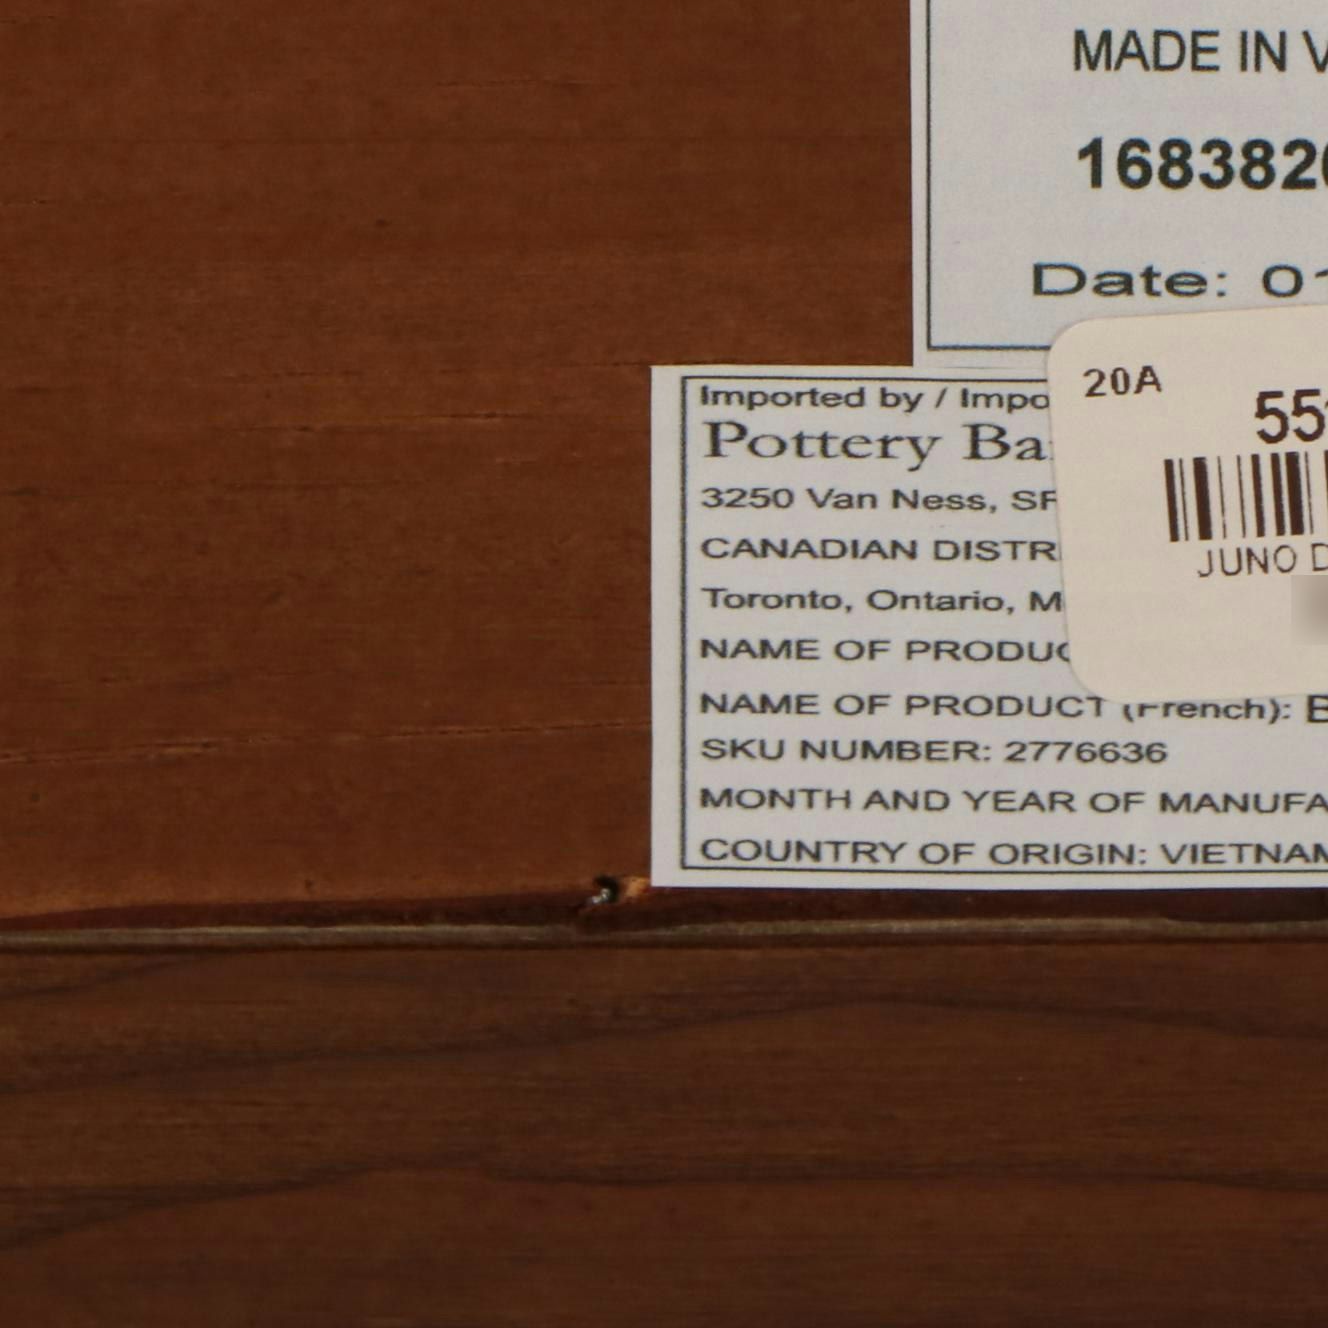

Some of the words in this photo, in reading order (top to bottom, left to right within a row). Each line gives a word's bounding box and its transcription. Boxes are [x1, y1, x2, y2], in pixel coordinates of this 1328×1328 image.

[1073, 28, 1221, 73] MADE
[1239, 29, 1288, 73] IN
[1032, 262, 1227, 295] Date:
[1082, 364, 1163, 398] 20A
[700, 384, 866, 412] Imported
[879, 386, 925, 414] by
[702, 419, 943, 473] Pottery
[700, 487, 795, 510] 3250
[805, 487, 878, 511] Van
[891, 488, 998, 514] Ness,
[1010, 489, 1057, 512] SF
[700, 537, 918, 561] CANADIAN
[1197, 544, 1297, 578] JUNO
[700, 587, 853, 614] Toronto,
[865, 588, 1015, 616] Ontario,
[699, 638, 821, 661] NAME
[833, 639, 891, 662] OF
[699, 692, 820, 716] NAME
[833, 693, 892, 717] OF
[904, 694, 1105, 718] PRODUCT
[700, 738, 785, 762] SKU
[799, 739, 991, 763] NUMBER:
[1004, 740, 1169, 765] 2776636
[699, 787, 852, 810] MONTH
[862, 789, 951, 812] AND
[961, 789, 1077, 814] YEAR
[1088, 791, 1146, 814] OF
[699, 838, 908, 865] COUNTRY
[918, 842, 976, 866] OF
[988, 842, 1147, 866] ORIGIN:
